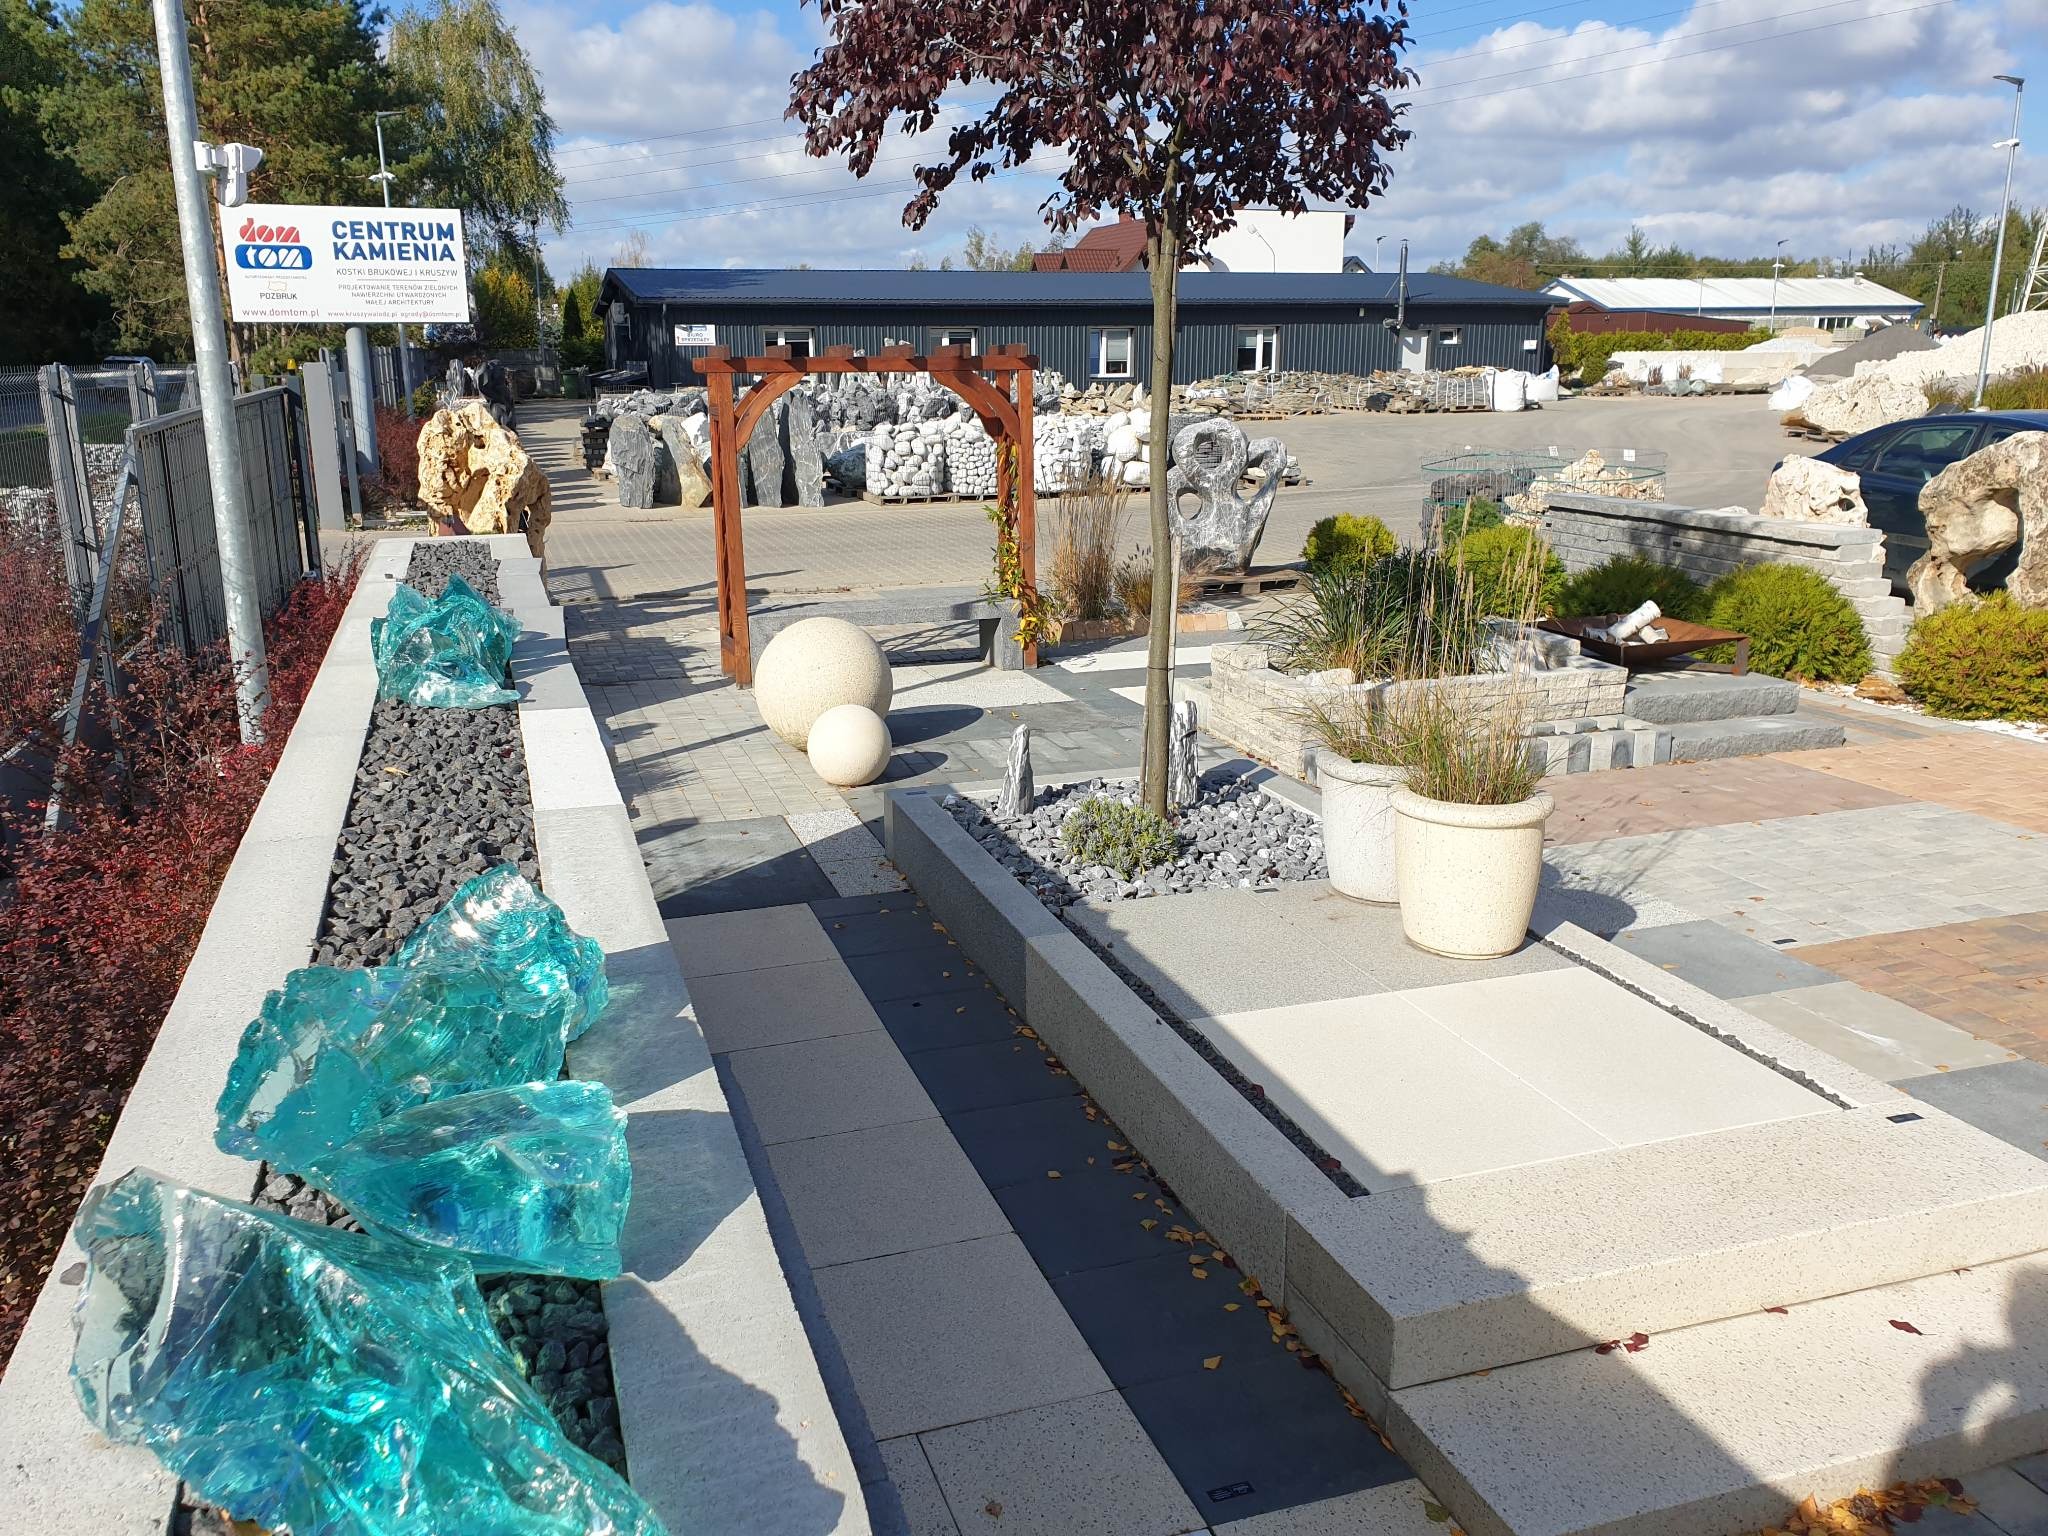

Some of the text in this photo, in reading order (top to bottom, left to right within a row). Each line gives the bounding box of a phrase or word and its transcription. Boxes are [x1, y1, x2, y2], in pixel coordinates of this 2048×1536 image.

[239, 218, 300, 243] dom
[331, 220, 455, 242] CENTRUM
[246, 246, 303, 268] tom
[332, 242, 456, 262] KAMIENIA
[336, 268, 366, 276] KOSTKI
[368, 268, 412, 276] BRUKOWEJ
[420, 269, 458, 277] KRUSZYW
[242, 308, 320, 318] www.domtom.pl
